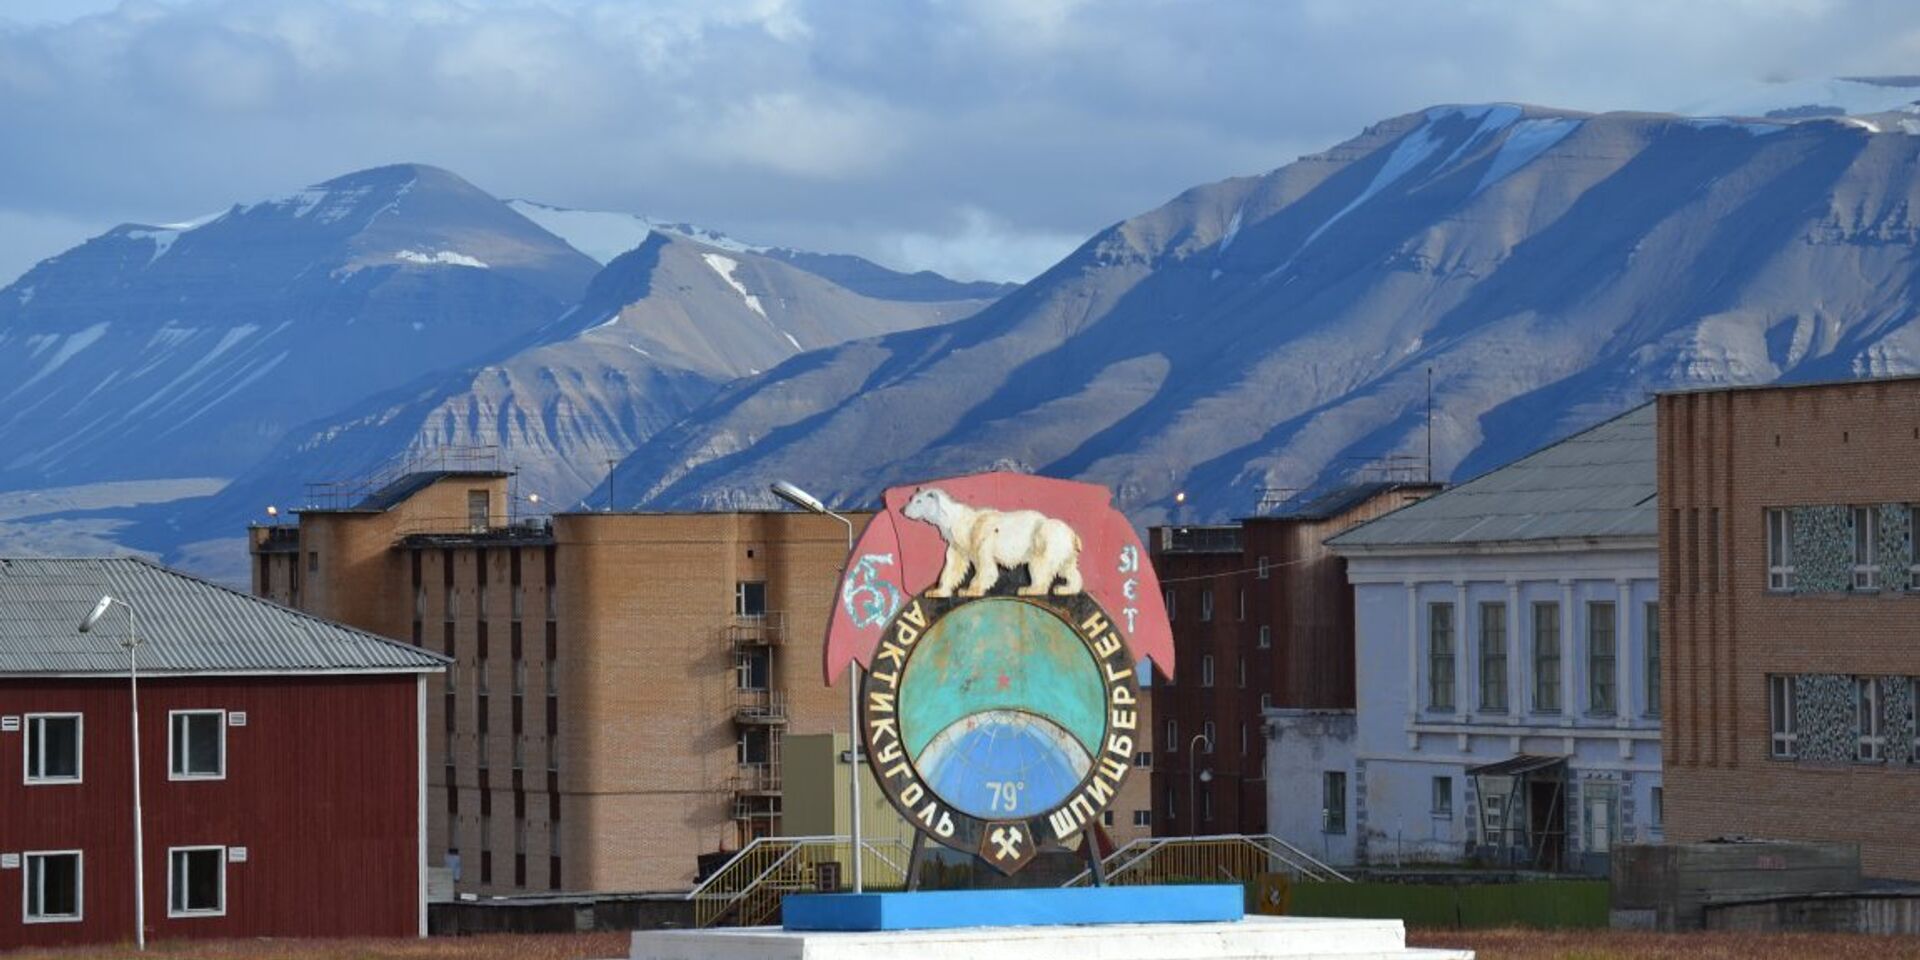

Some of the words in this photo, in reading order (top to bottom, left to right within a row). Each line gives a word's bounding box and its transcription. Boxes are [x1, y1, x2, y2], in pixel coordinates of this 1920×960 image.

[869, 600, 955, 837] АРКТИКУГОЛЬ
[986, 781, 1024, 811] 79°
[1049, 611, 1137, 839] ШПИЦБЕРГЕН
